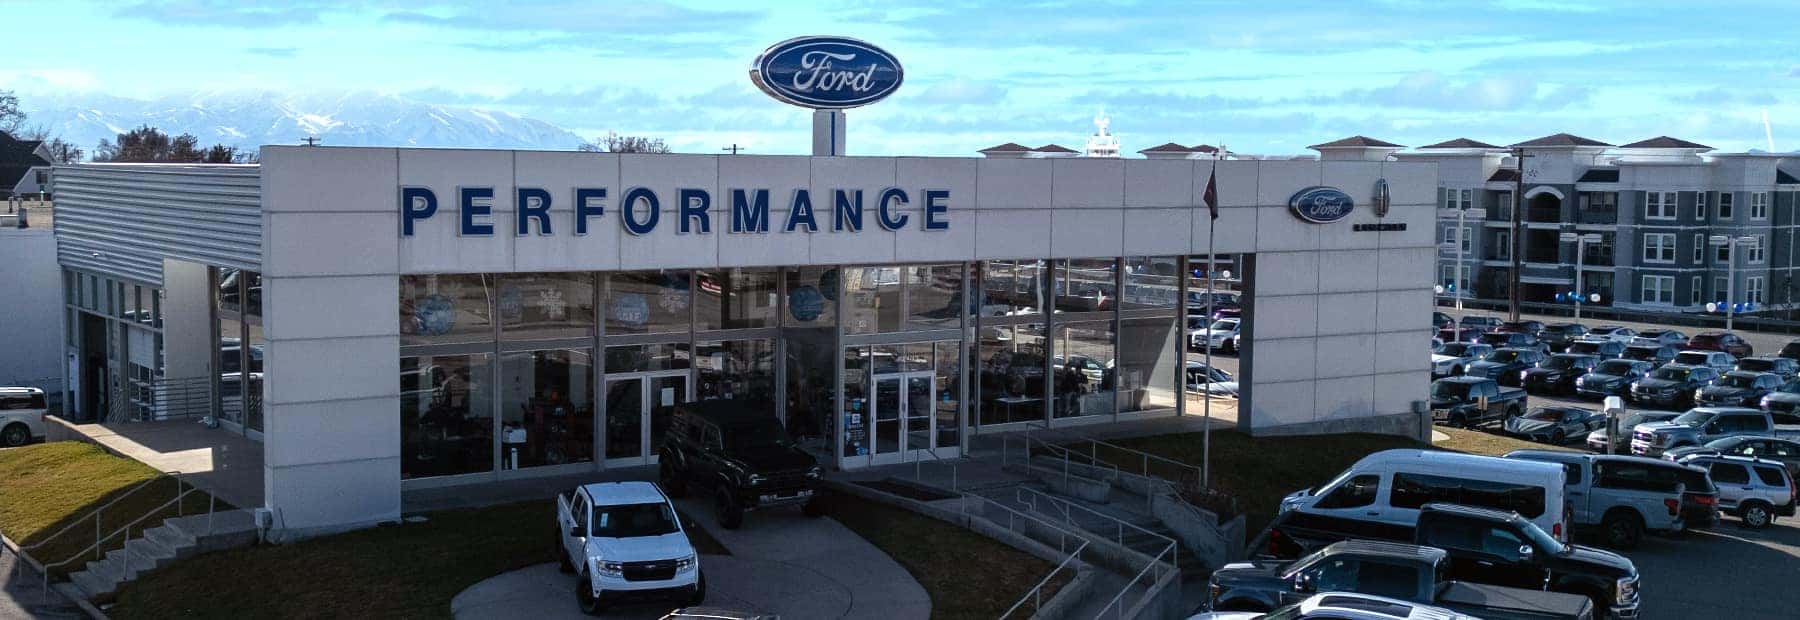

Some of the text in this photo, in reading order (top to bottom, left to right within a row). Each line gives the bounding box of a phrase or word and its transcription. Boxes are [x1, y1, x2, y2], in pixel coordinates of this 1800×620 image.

[793, 51, 877, 92] Ford
[400, 185, 951, 238] PERFORMANCE
[1310, 195, 1343, 216] Ford
